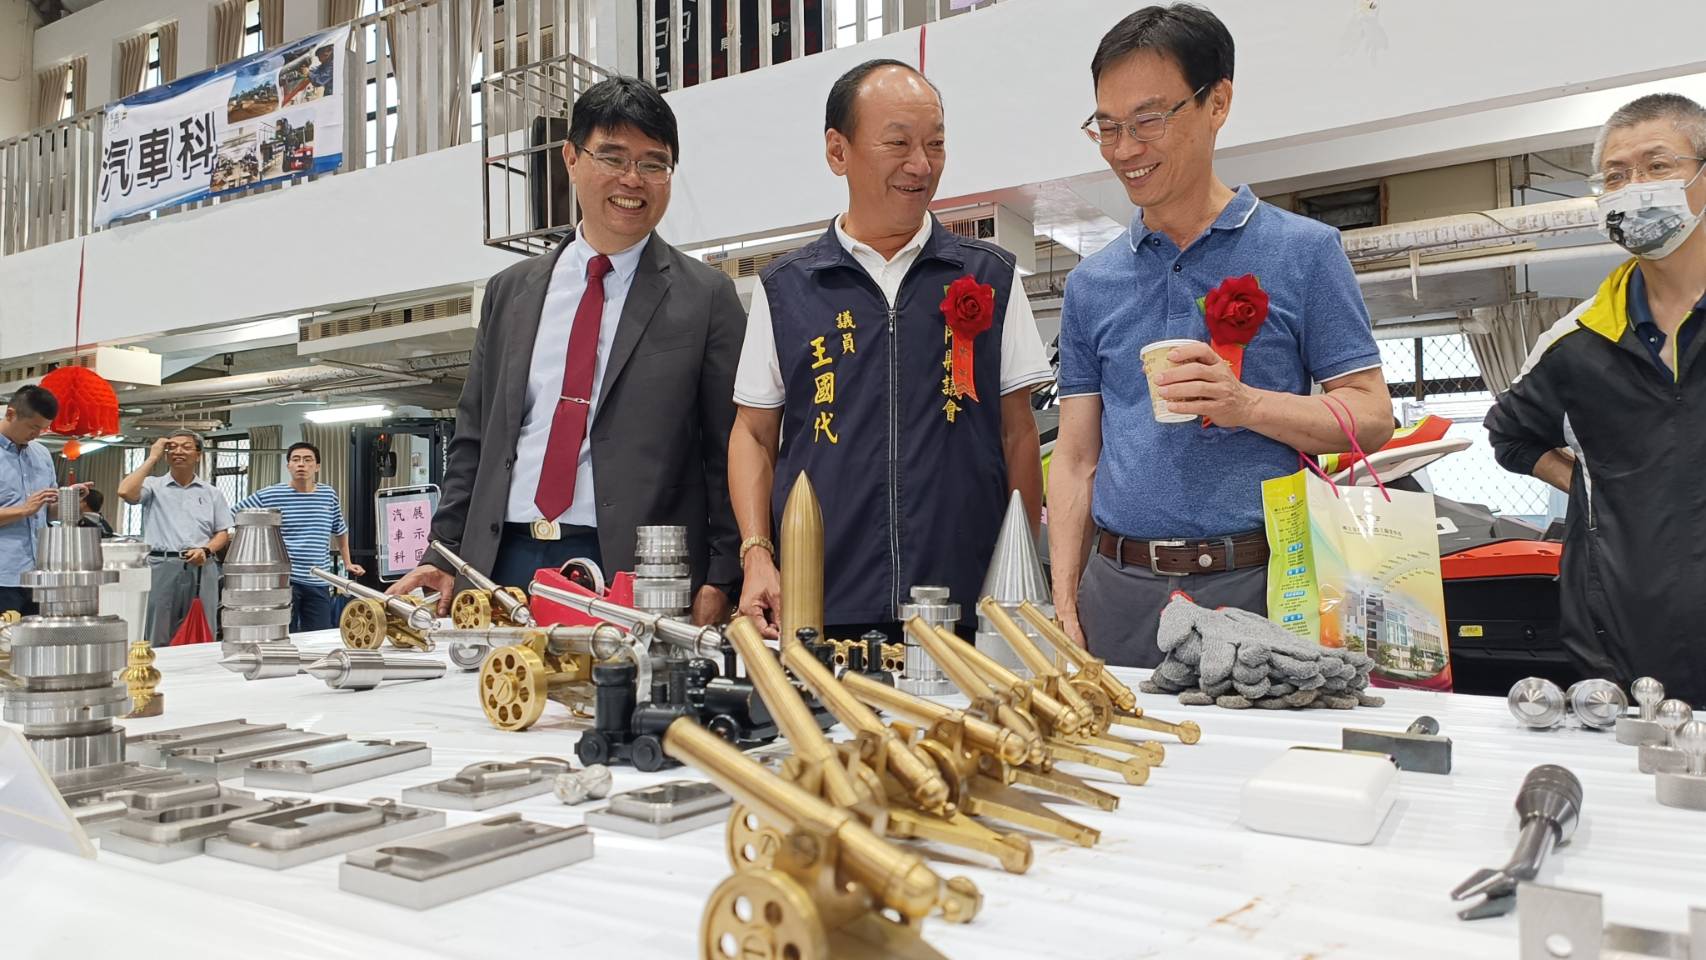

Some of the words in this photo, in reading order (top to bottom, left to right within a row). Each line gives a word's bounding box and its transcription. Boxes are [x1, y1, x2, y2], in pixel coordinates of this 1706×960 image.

[102, 112, 216, 201] 汽車科
[836, 311, 855, 354] 議員
[811, 337, 838, 444] 王國代
[393, 509, 406, 564] 汽車科
